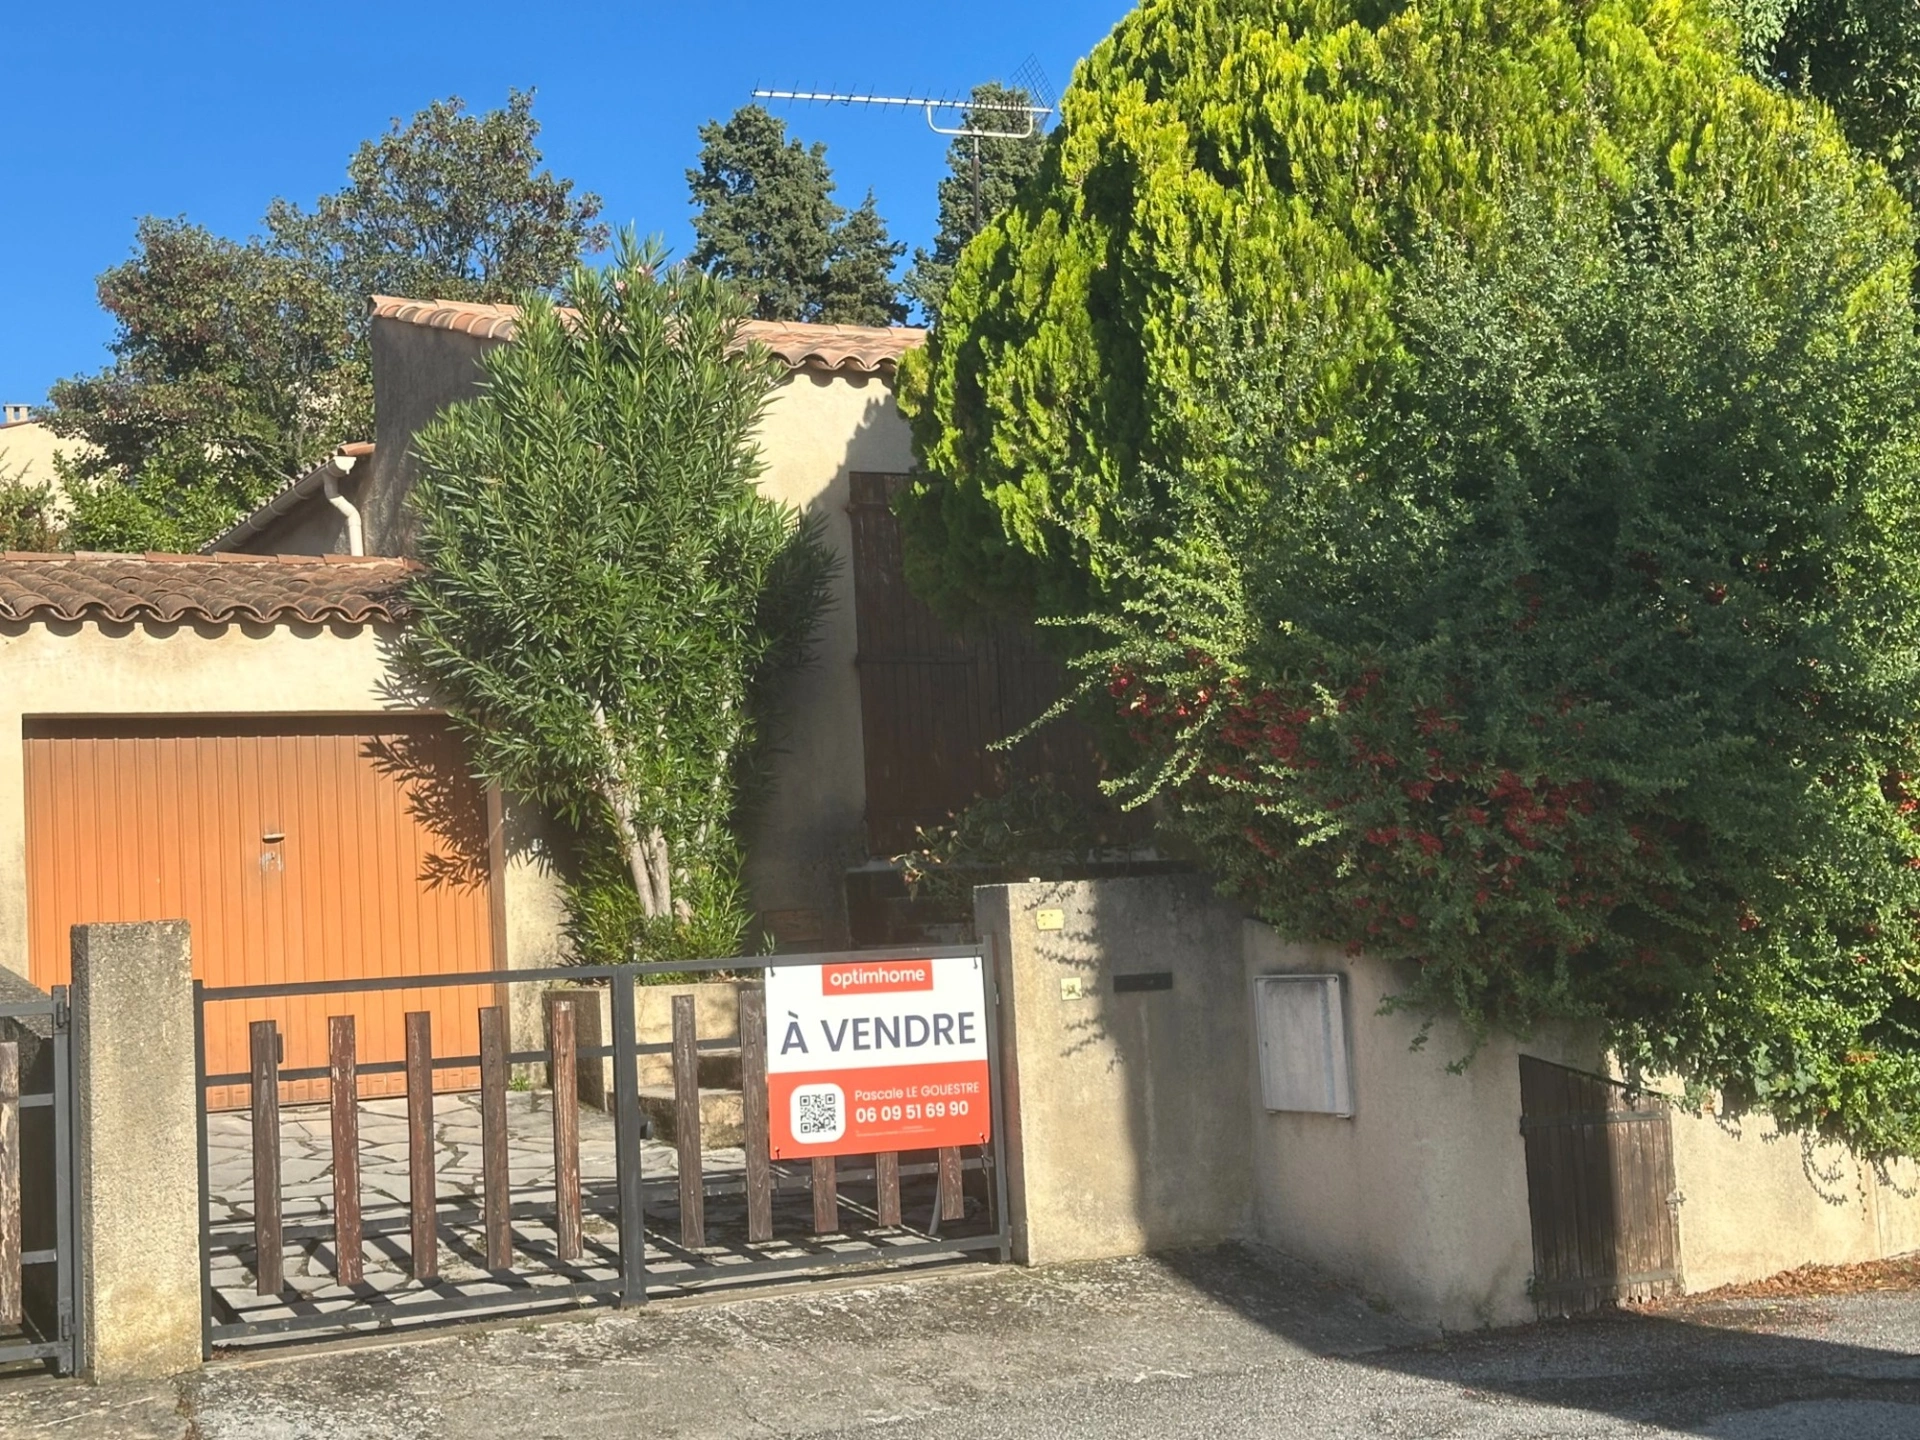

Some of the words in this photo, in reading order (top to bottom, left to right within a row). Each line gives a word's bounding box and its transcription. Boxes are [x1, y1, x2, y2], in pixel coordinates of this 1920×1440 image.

[830, 968, 926, 988] optimhome
[780, 1010, 809, 1055] À
[821, 1011, 976, 1052] VENDRE
[854, 1088, 904, 1102] Pascale
[906, 1087, 919, 1098] LE
[921, 1082, 980, 1096] GOUESTRE
[855, 1108, 877, 1123] 06
[881, 1106, 902, 1122] 09
[905, 1104, 922, 1119] 51
[925, 1102, 946, 1118] 69
[950, 1100, 969, 1116] 90
